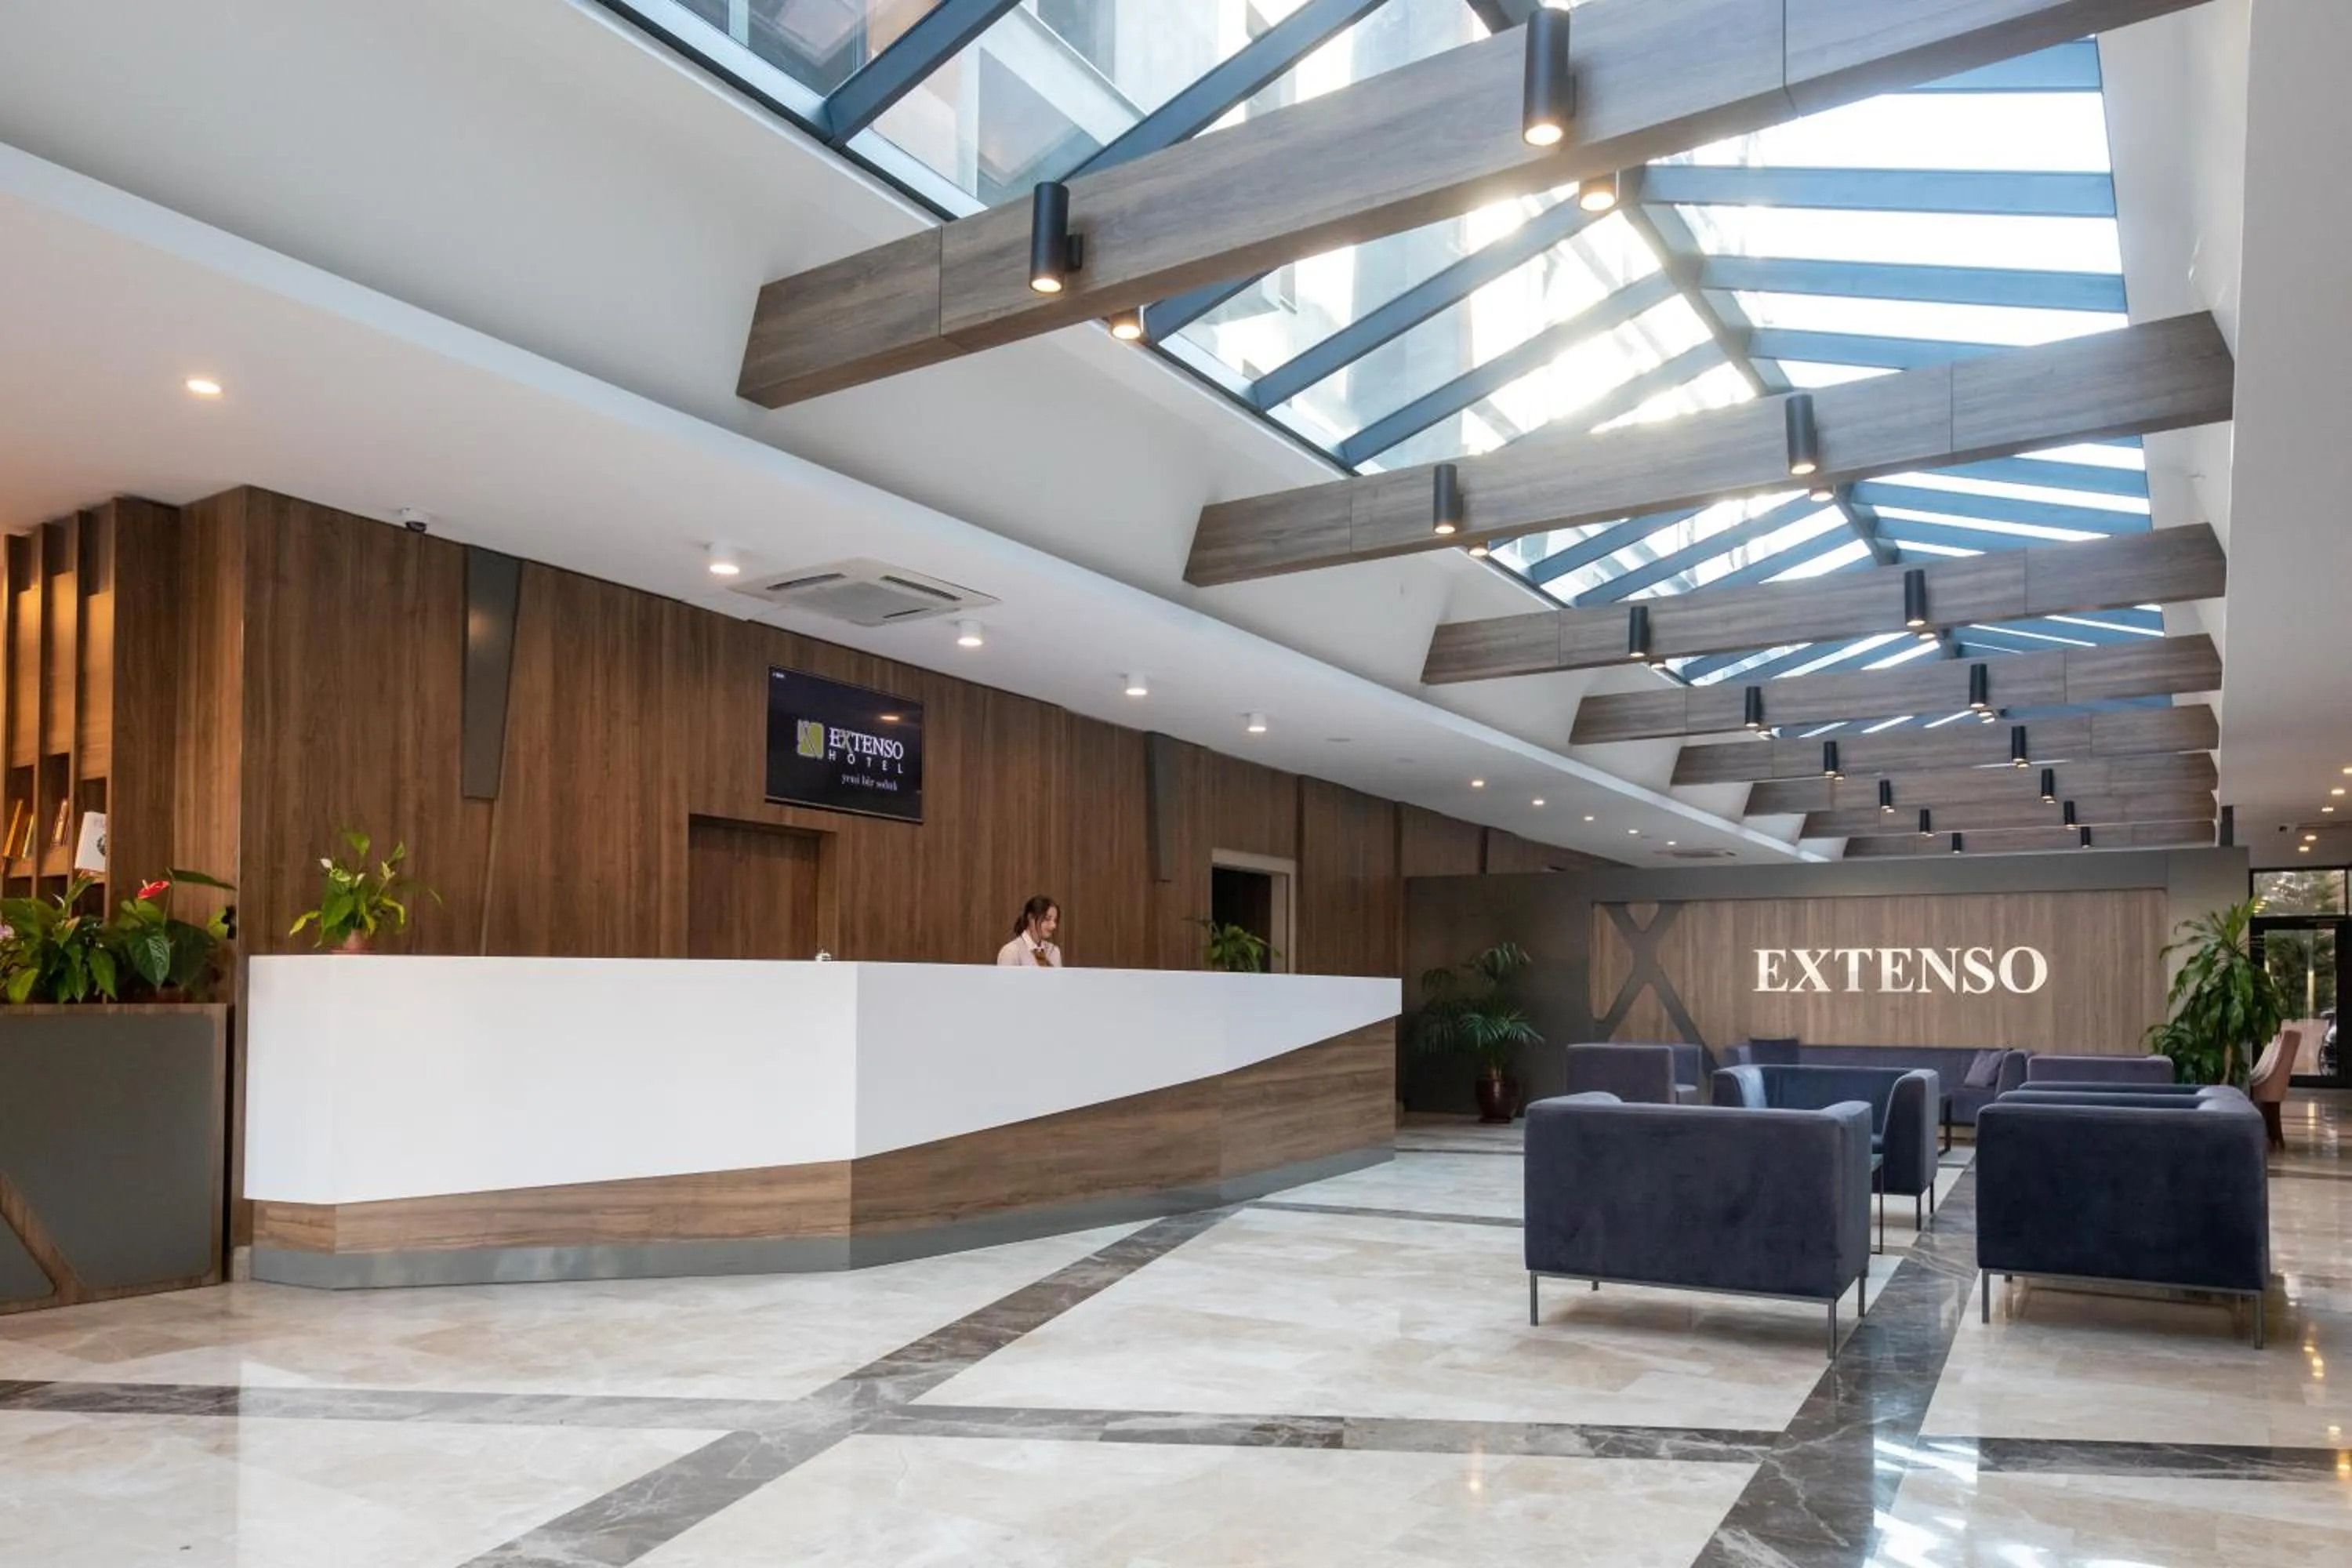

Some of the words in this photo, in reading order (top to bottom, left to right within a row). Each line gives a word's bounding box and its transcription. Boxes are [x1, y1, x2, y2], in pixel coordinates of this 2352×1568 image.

[829, 727, 904, 760] EXTENSO
[828, 749, 903, 774] HOTEL
[1753, 946, 2048, 993] EXTENSO
